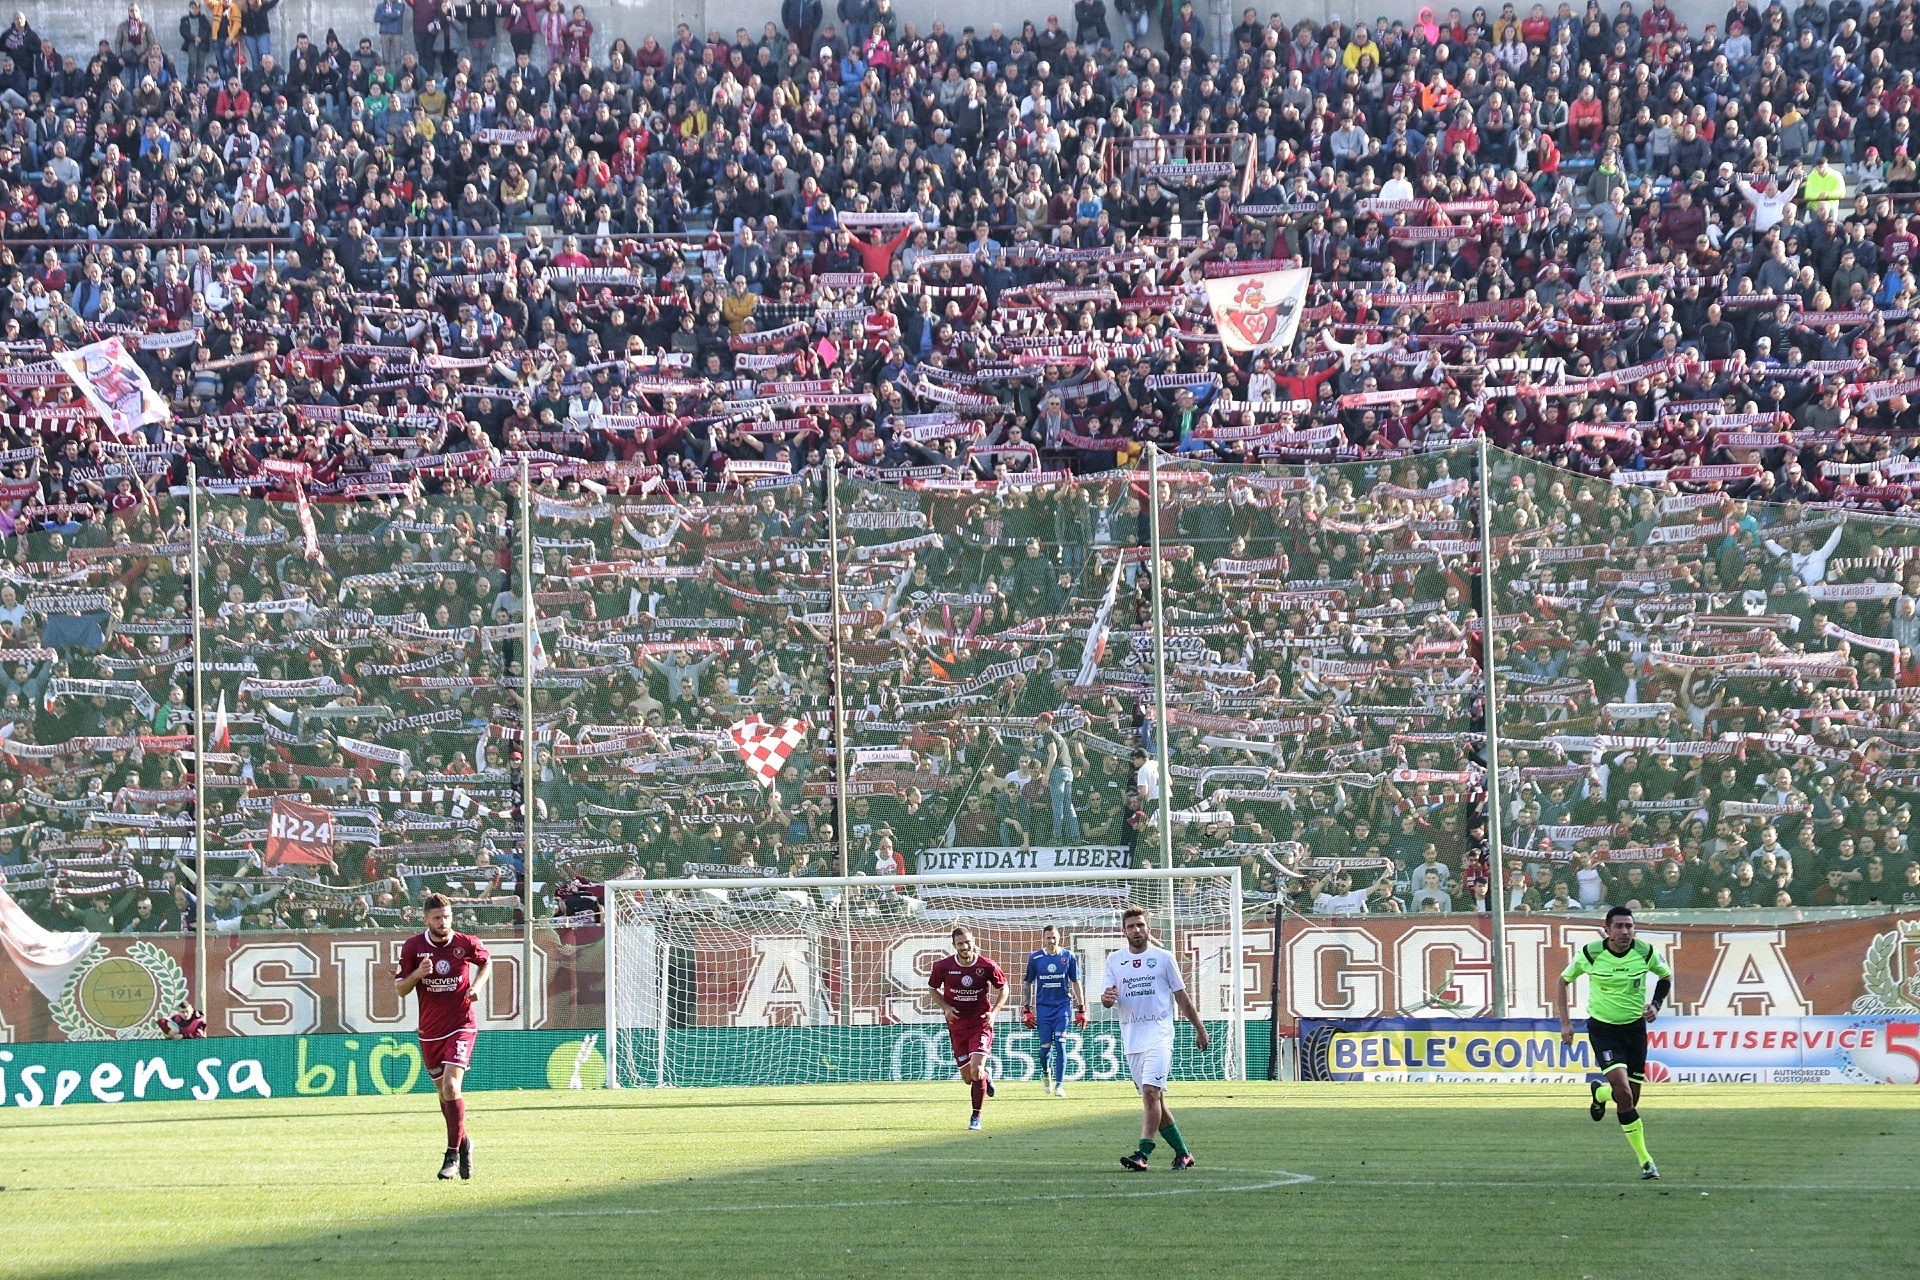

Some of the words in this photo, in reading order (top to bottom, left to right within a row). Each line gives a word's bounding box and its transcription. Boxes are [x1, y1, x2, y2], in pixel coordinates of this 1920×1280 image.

[1410, 228, 1438, 239] REGGINA
[1440, 228, 1455, 237] 1914
[821, 276, 847, 287] REGGINA
[849, 276, 864, 285] 1914
[1387, 294, 1410, 304] FORZA
[1413, 293, 1446, 303] REGGINA
[1805, 314, 1828, 323] FORZA
[1833, 312, 1868, 322] REGGINA
[142, 336, 167, 348] Reggina
[169, 331, 192, 346] Calcio
[8, 374, 38, 385] REGGINA
[42, 375, 56, 385] 1914
[775, 384, 805, 394] REGGINA
[807, 382, 821, 392] 1914
[934, 389, 946, 399] VAI
[1545, 384, 1572, 394] REGGINA
[1574, 383, 1588, 392] 1914
[1875, 387, 1887, 400] VAI
[1723, 416, 1735, 426] VAI
[1737, 413, 1773, 425] REGGINA
[753, 422, 784, 433] REGGINA
[786, 421, 799, 430] 1914
[919, 427, 933, 438] VAI
[935, 423, 970, 437] REGGINA
[1214, 427, 1242, 437] REGGINA
[1246, 426, 1260, 436] 1914
[1730, 435, 1760, 445] REGGINA
[1763, 435, 1779, 444] 1914
[885, 470, 906, 478] FORZA
[910, 466, 942, 476] REGGINA
[1010, 475, 1022, 485] VAI
[1027, 471, 1063, 484] REGGINA
[1691, 468, 1723, 478] REGGINA
[1727, 467, 1742, 477] 1914
[1669, 500, 1683, 510] VAI
[1686, 494, 1722, 508] REGGINA
[1669, 527, 1683, 537] VAI
[1686, 523, 1723, 537] REGGINA
[1569, 551, 1583, 559] 1914
[1226, 562, 1239, 572] VAI
[1240, 558, 1278, 572] REGGINA
[1622, 571, 1655, 581] REGGINA
[1657, 570, 1673, 579] 1914
[965, 594, 992, 603] SUD
[1172, 624, 1239, 635] REGGINA
[1264, 637, 1339, 648] SALERNO
[373, 651, 454, 676] WARRIORS
[1320, 663, 1333, 673] VAI
[1336, 662, 1374, 673] REGGINA
[422, 678, 455, 686] REGGINA
[457, 677, 473, 685] 1914
[382, 709, 460, 732] WARRIORS
[1677, 743, 1690, 754] VAI
[1693, 741, 1733, 754] REGGINA
[1765, 741, 1850, 760] ULTRAS
[859, 784, 874, 793] 1914
[680, 814, 754, 824] REGGINA
[271, 813, 331, 844] H224
[1556, 828, 1569, 837] VAI
[1573, 825, 1611, 837] REGGINA
[924, 850, 1037, 870] DIFFIDATI
[1054, 849, 1130, 868] LIBERI
[1610, 850, 1645, 860] REGGINA
[1647, 848, 1663, 859] 1914
[1313, 858, 1341, 866] FORZA
[1344, 858, 1382, 866] REGGINA
[700, 865, 725, 873] FORZA
[728, 865, 763, 874] REGGINA
[110, 987, 142, 999] 1914
[225, 941, 548, 1035] SUD
[1647, 1029, 1876, 1049] MULTISERVICE
[1335, 1036, 1457, 1068] BELLE'
[1466, 1038, 1598, 1069] GOMM
